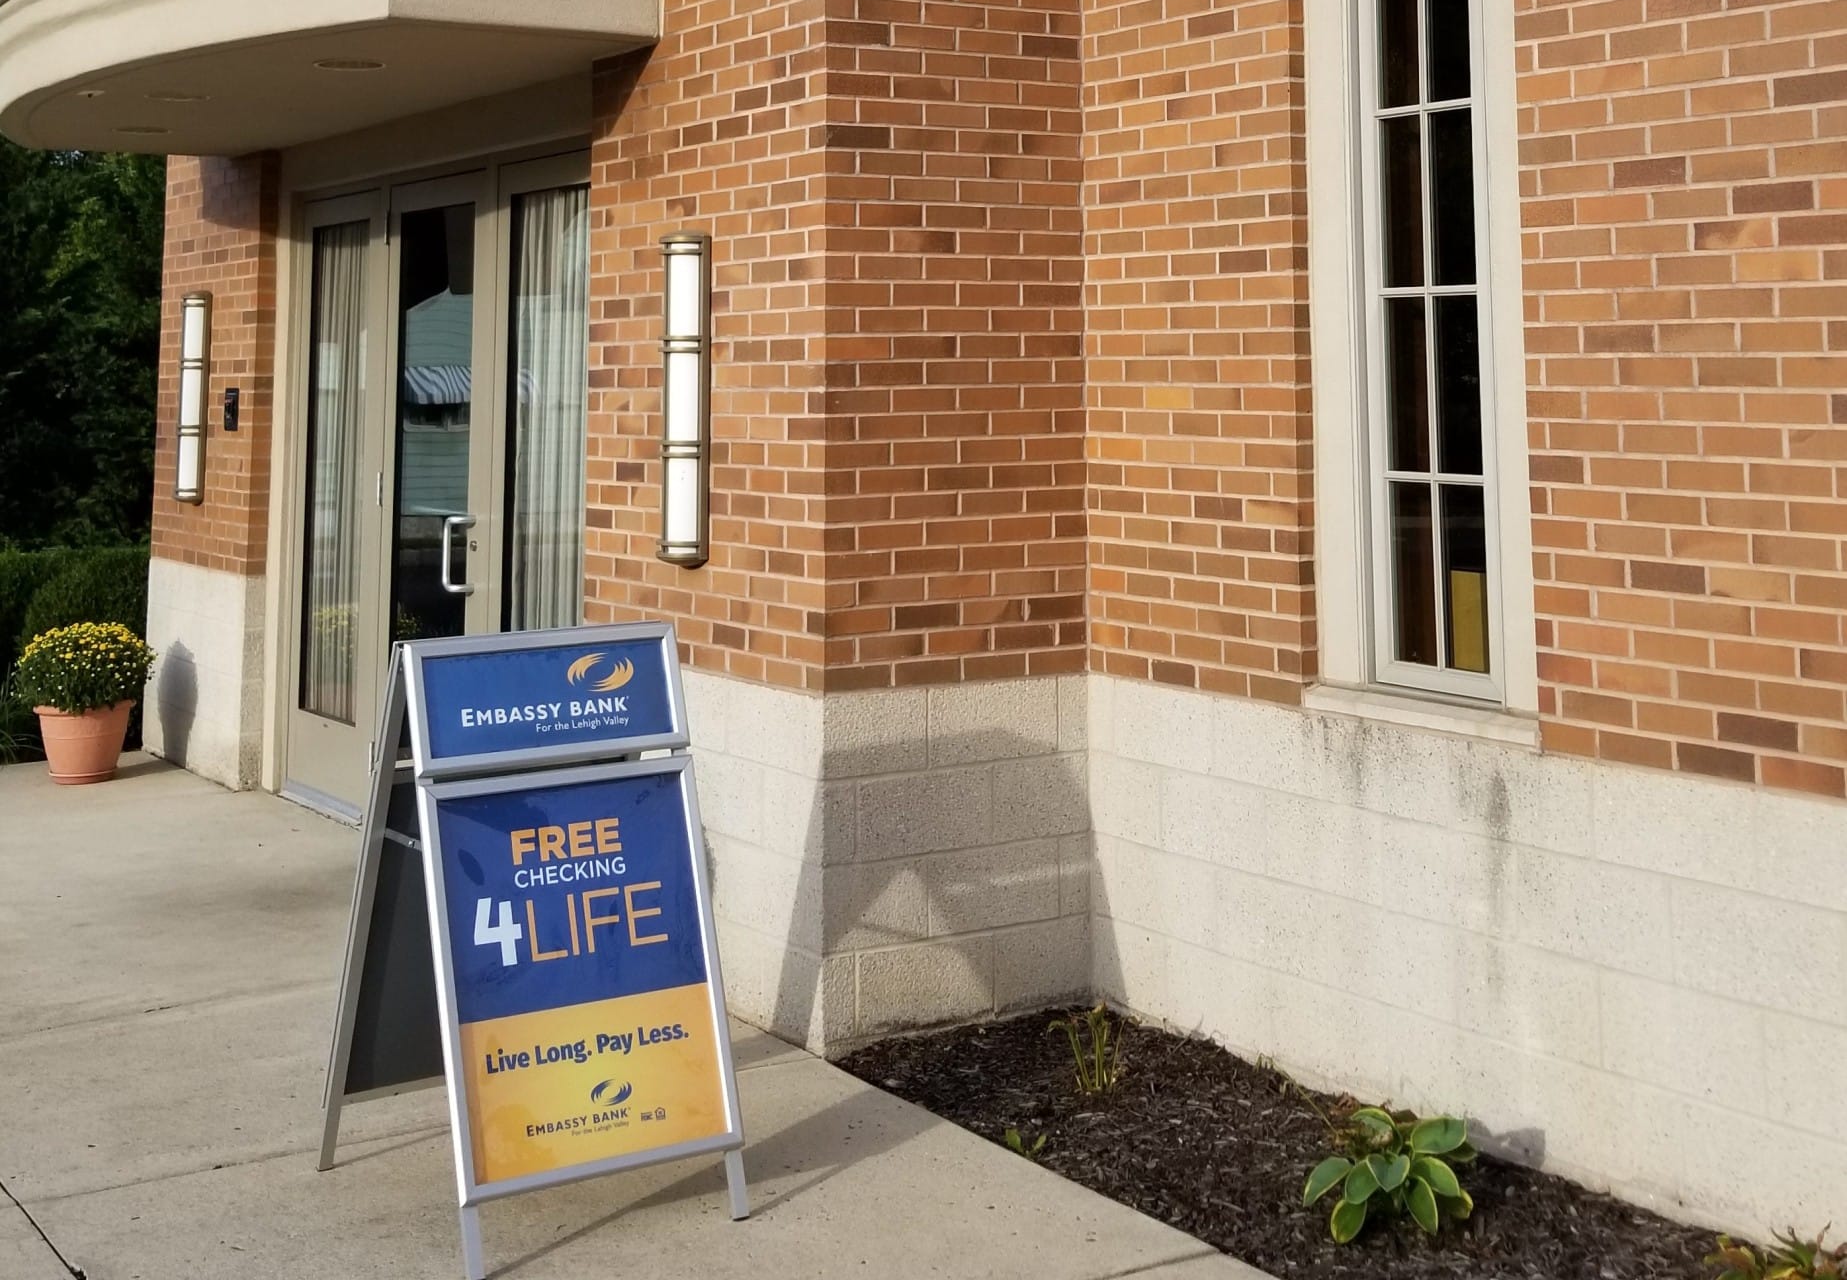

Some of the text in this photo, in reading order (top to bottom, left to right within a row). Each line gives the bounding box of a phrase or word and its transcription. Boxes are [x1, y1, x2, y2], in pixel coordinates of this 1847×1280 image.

[461, 696, 628, 728] EMBASSY BANK
[536, 715, 629, 733] For the Lehigh Valley
[510, 818, 623, 865] FREE
[514, 856, 627, 888] CHECKING
[486, 1023, 689, 1074] Live Long. Pay Less.
[526, 1115, 588, 1137] EMBASSY
[593, 1108, 628, 1124] BANK
